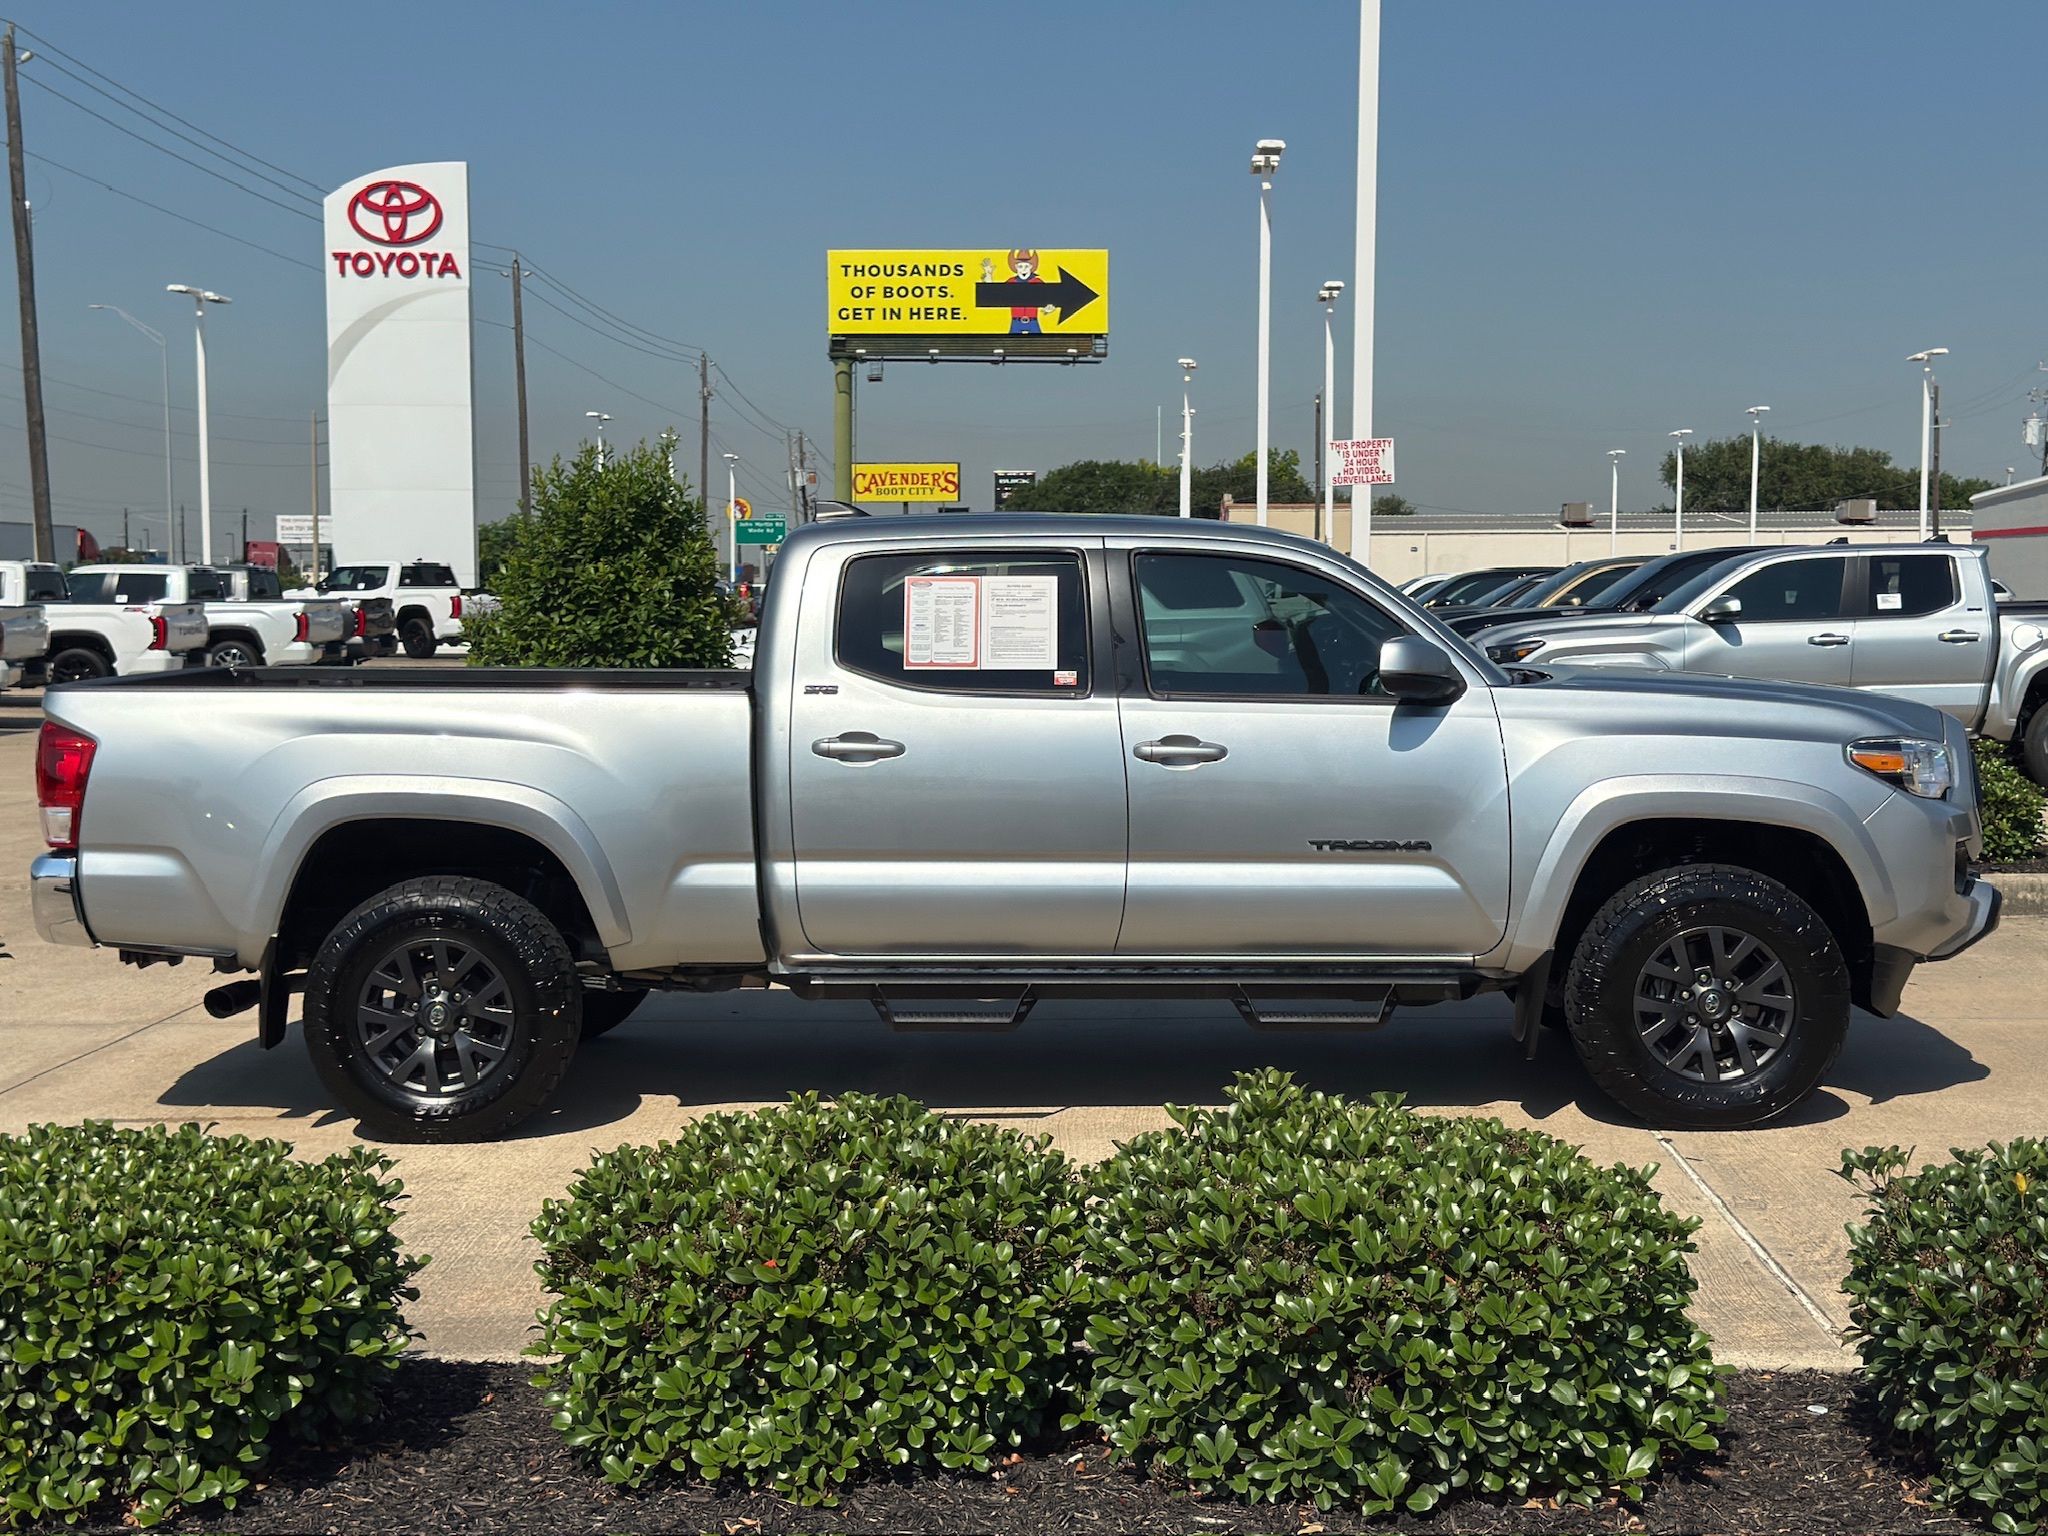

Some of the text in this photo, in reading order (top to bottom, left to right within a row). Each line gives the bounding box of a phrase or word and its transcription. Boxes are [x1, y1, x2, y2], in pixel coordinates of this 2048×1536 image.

[332, 252, 462, 279] TOYOTA
[841, 264, 964, 277] THOUSANDS
[851, 285, 954, 298] OF BOOTS.
[838, 307, 967, 320] GET IN HERE.
[1329, 440, 1392, 451] THIS PROPERTY
[1353, 449, 1380, 458] UNDER
[1344, 458, 1379, 467] 24 HOUR
[1356, 466, 1380, 475] VIDEO
[853, 470, 960, 494] CAVENDER'S
[1332, 475, 1392, 484] SURVEILLANCE
[876, 486, 936, 496] BOOT CITY
[1307, 839, 1433, 851] TACOMA
